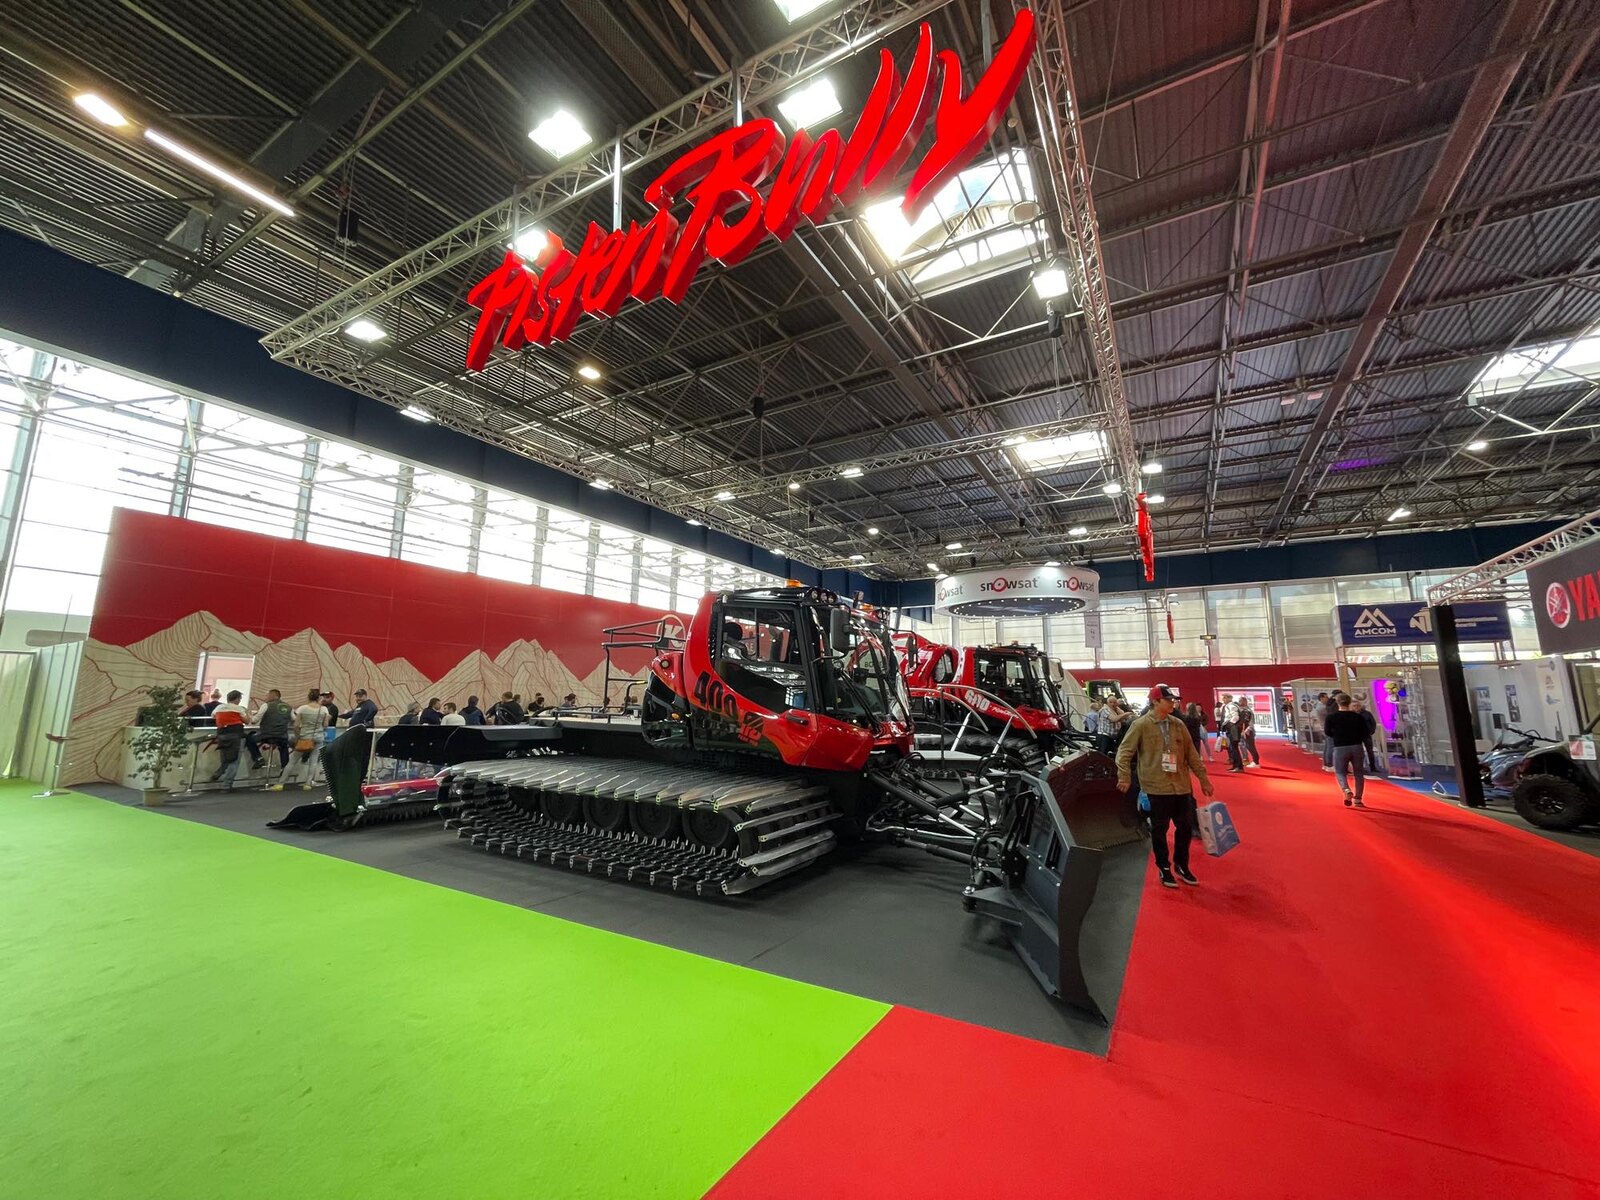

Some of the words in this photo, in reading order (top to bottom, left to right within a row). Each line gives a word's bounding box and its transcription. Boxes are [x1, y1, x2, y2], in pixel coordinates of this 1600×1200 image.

[980, 577, 1038, 593] snowsat
[1056, 577, 1095, 592] snowsat
[1567, 570, 1600, 621] YA
[1354, 627, 1397, 636] AMCOM
[694, 671, 739, 720] 400
